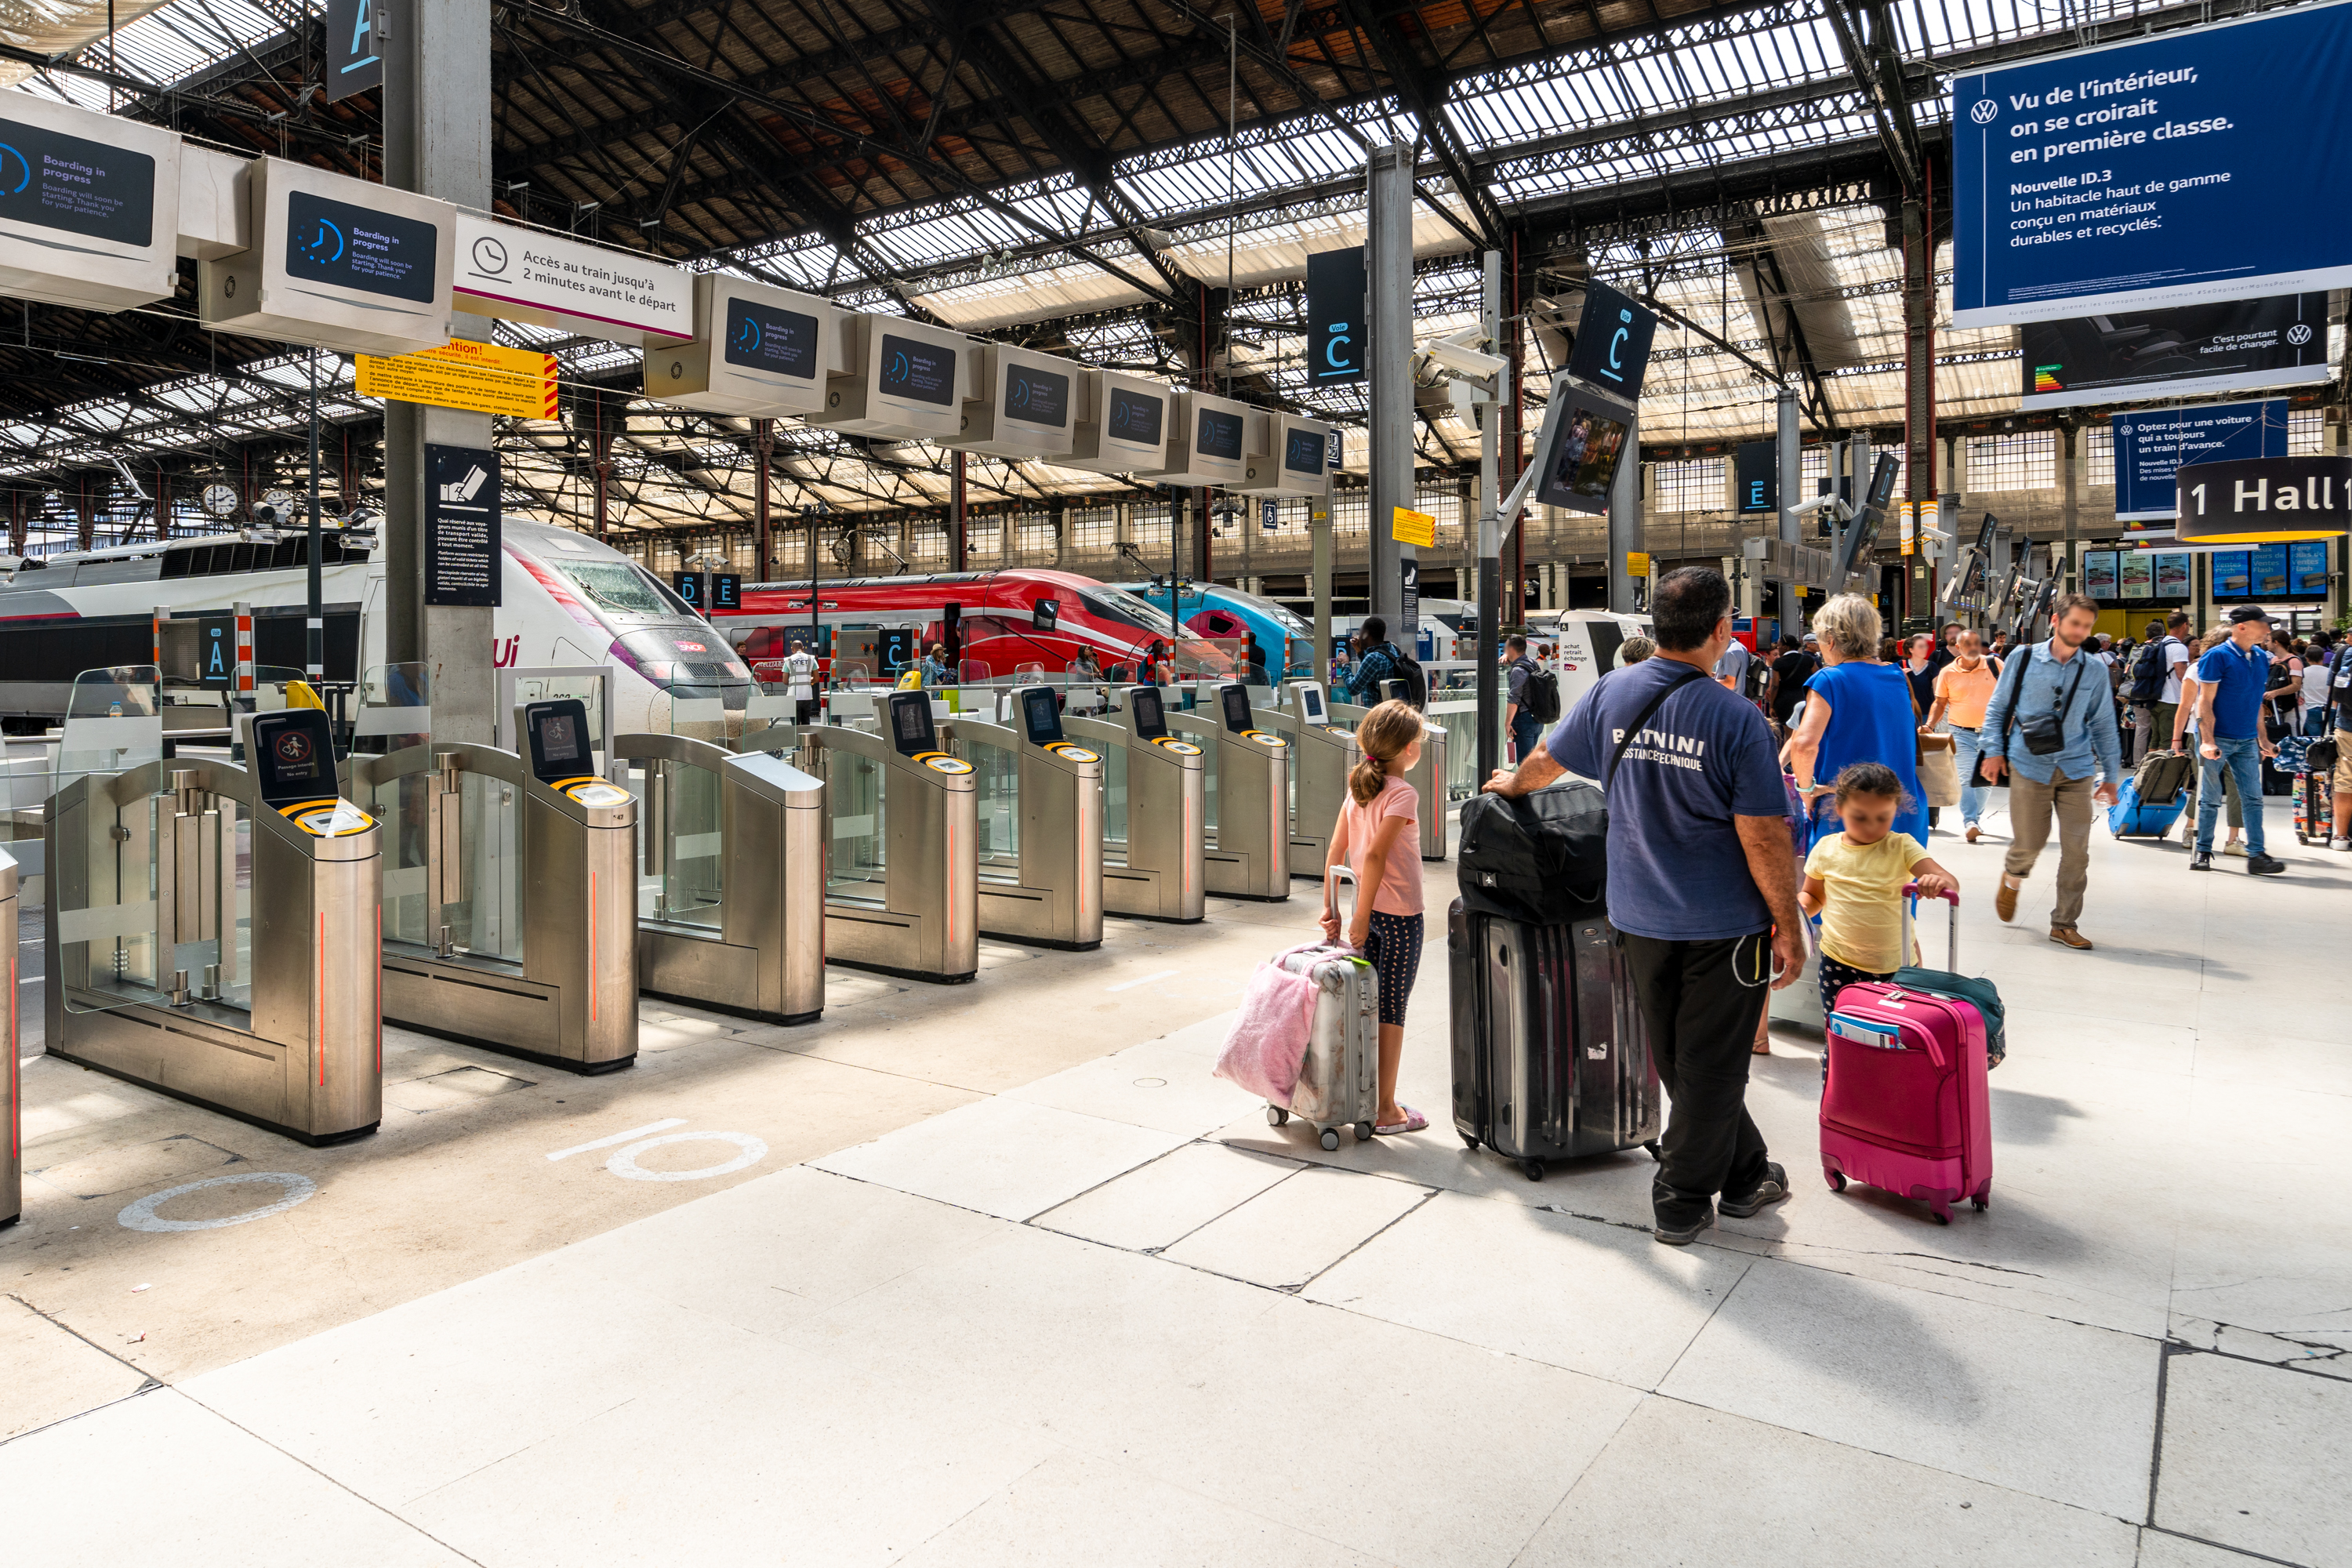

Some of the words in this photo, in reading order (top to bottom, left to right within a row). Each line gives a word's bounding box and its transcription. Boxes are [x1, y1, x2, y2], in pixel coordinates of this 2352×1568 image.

[2011, 93, 2038, 111] Vu
[2045, 87, 2073, 106] de
[2079, 70, 2198, 100] l'intérieur,
[2011, 122, 2038, 138] on
[2044, 117, 2068, 132] se
[2075, 96, 2158, 127] croirait
[2011, 147, 2037, 164] en
[2044, 129, 2146, 164] première
[2152, 117, 2234, 141] classe.
[44, 155, 92, 176] Boarding
[96, 167, 105, 176] in
[44, 169, 91, 183] progress
[2011, 175, 2077, 195] Nouvelle
[2081, 169, 2112, 186] ID.3
[42, 183, 77, 198] Boarding
[94, 195, 112, 204] soon
[42, 191, 74, 204] starting.
[76, 198, 99, 208] Thank
[2011, 199, 2031, 212] Un
[2034, 189, 2101, 209] habitacle
[2106, 182, 2140, 199] haut
[2144, 180, 2164, 194] de
[2169, 172, 2231, 194] gamme
[74, 205, 108, 218] patience.
[2011, 215, 2053, 230] conçu
[2057, 212, 2075, 223] en
[2080, 200, 2156, 220] matériaux
[354, 227, 389, 244] Boarding
[2011, 228, 2072, 246] durables
[2076, 223, 2092, 238] et
[354, 239, 389, 251] progress
[352, 259, 376, 269] starting.
[376, 263, 394, 271] Thank
[353, 252, 378, 263] Boarding
[375, 270, 401, 279] patience.
[524, 251, 559, 270] Accès
[563, 263, 578, 274] au
[582, 263, 609, 281] train
[612, 270, 654, 290] jusqu'à
[524, 268, 531, 281] 2
[535, 273, 585, 292] minutes
[588, 285, 622, 299] avant
[625, 289, 635, 303] le
[639, 292, 676, 311] départ
[2020, 307, 2059, 316] quotidien,
[2104, 296, 2145, 305] transports
[766, 323, 788, 335] Boarding
[2212, 334, 2234, 343] C'est
[2236, 329, 2277, 343] pourtant
[1327, 336, 1351, 367] C
[1610, 327, 1628, 370] C
[2200, 343, 2223, 354] facile
[2239, 339, 2278, 349] changer.
[2138, 423, 2166, 434] Optez
[2169, 422, 2191, 431] pour
[2215, 416, 2252, 425] voiture
[2139, 434, 2153, 444] qui
[2164, 431, 2205, 441] toujours
[2153, 443, 2176, 452] train
[2178, 441, 2225, 450] d'avance.
[1751, 488, 1764, 504] E
[2191, 484, 2205, 515] 1
[2234, 477, 2334, 512] Hall
[682, 583, 695, 600] D
[722, 586, 731, 601] E
[209, 641, 223, 673] A
[889, 644, 902, 666] C
